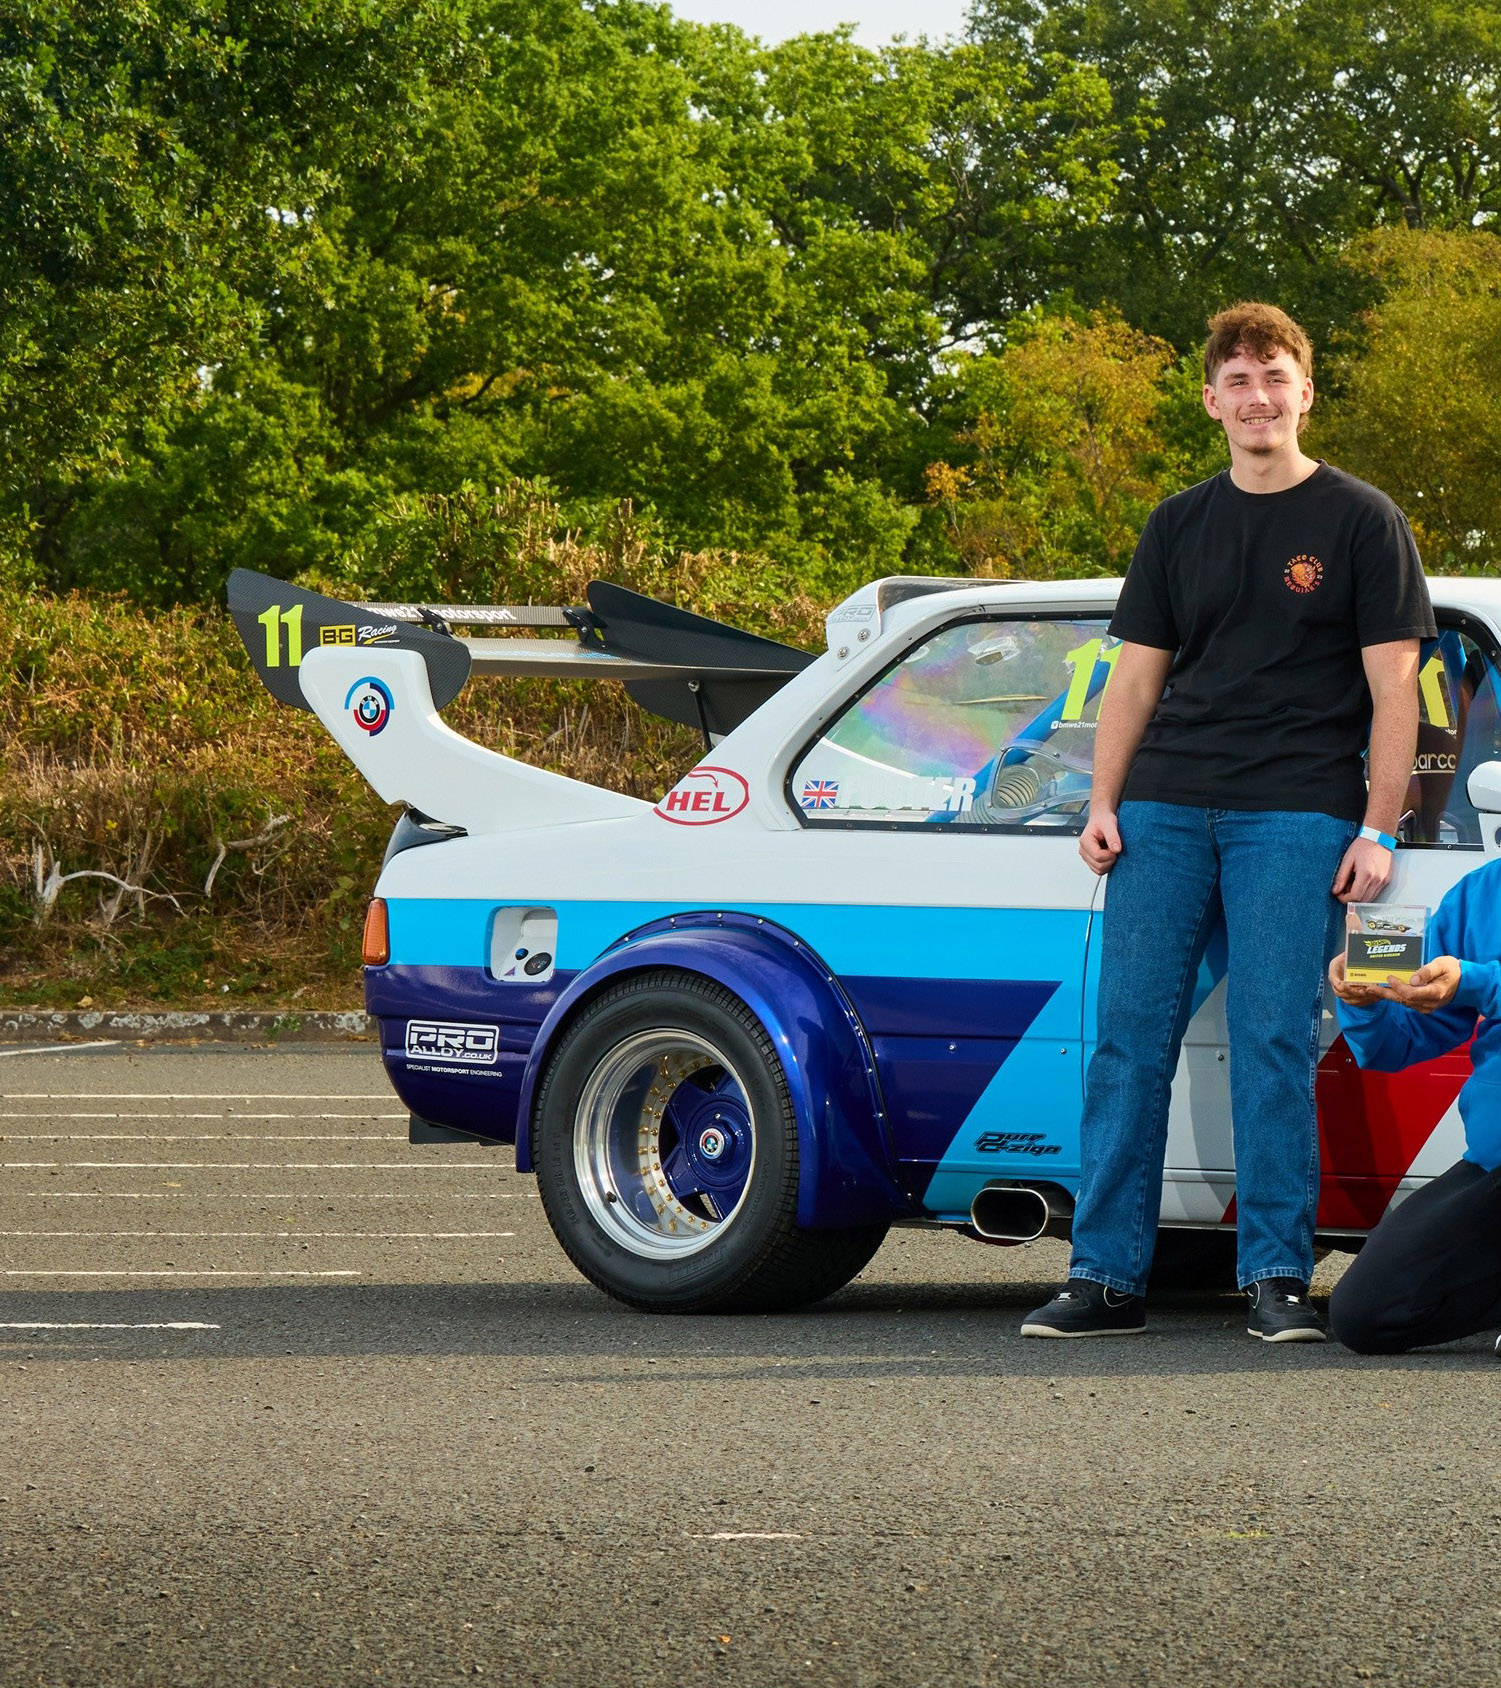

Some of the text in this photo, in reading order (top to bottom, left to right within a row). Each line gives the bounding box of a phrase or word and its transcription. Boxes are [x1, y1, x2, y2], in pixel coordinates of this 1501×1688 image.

[258, 604, 304, 668] 11
[357, 624, 398, 642] Racing
[666, 791, 732, 812] HEL
[1366, 943, 1407, 955] LEGENDS
[410, 1026, 494, 1051] PRO
[406, 1063, 503, 1078] SPECIALIST MOTORSPORT ENGINEERING
[974, 1131, 1047, 1146] Pure
